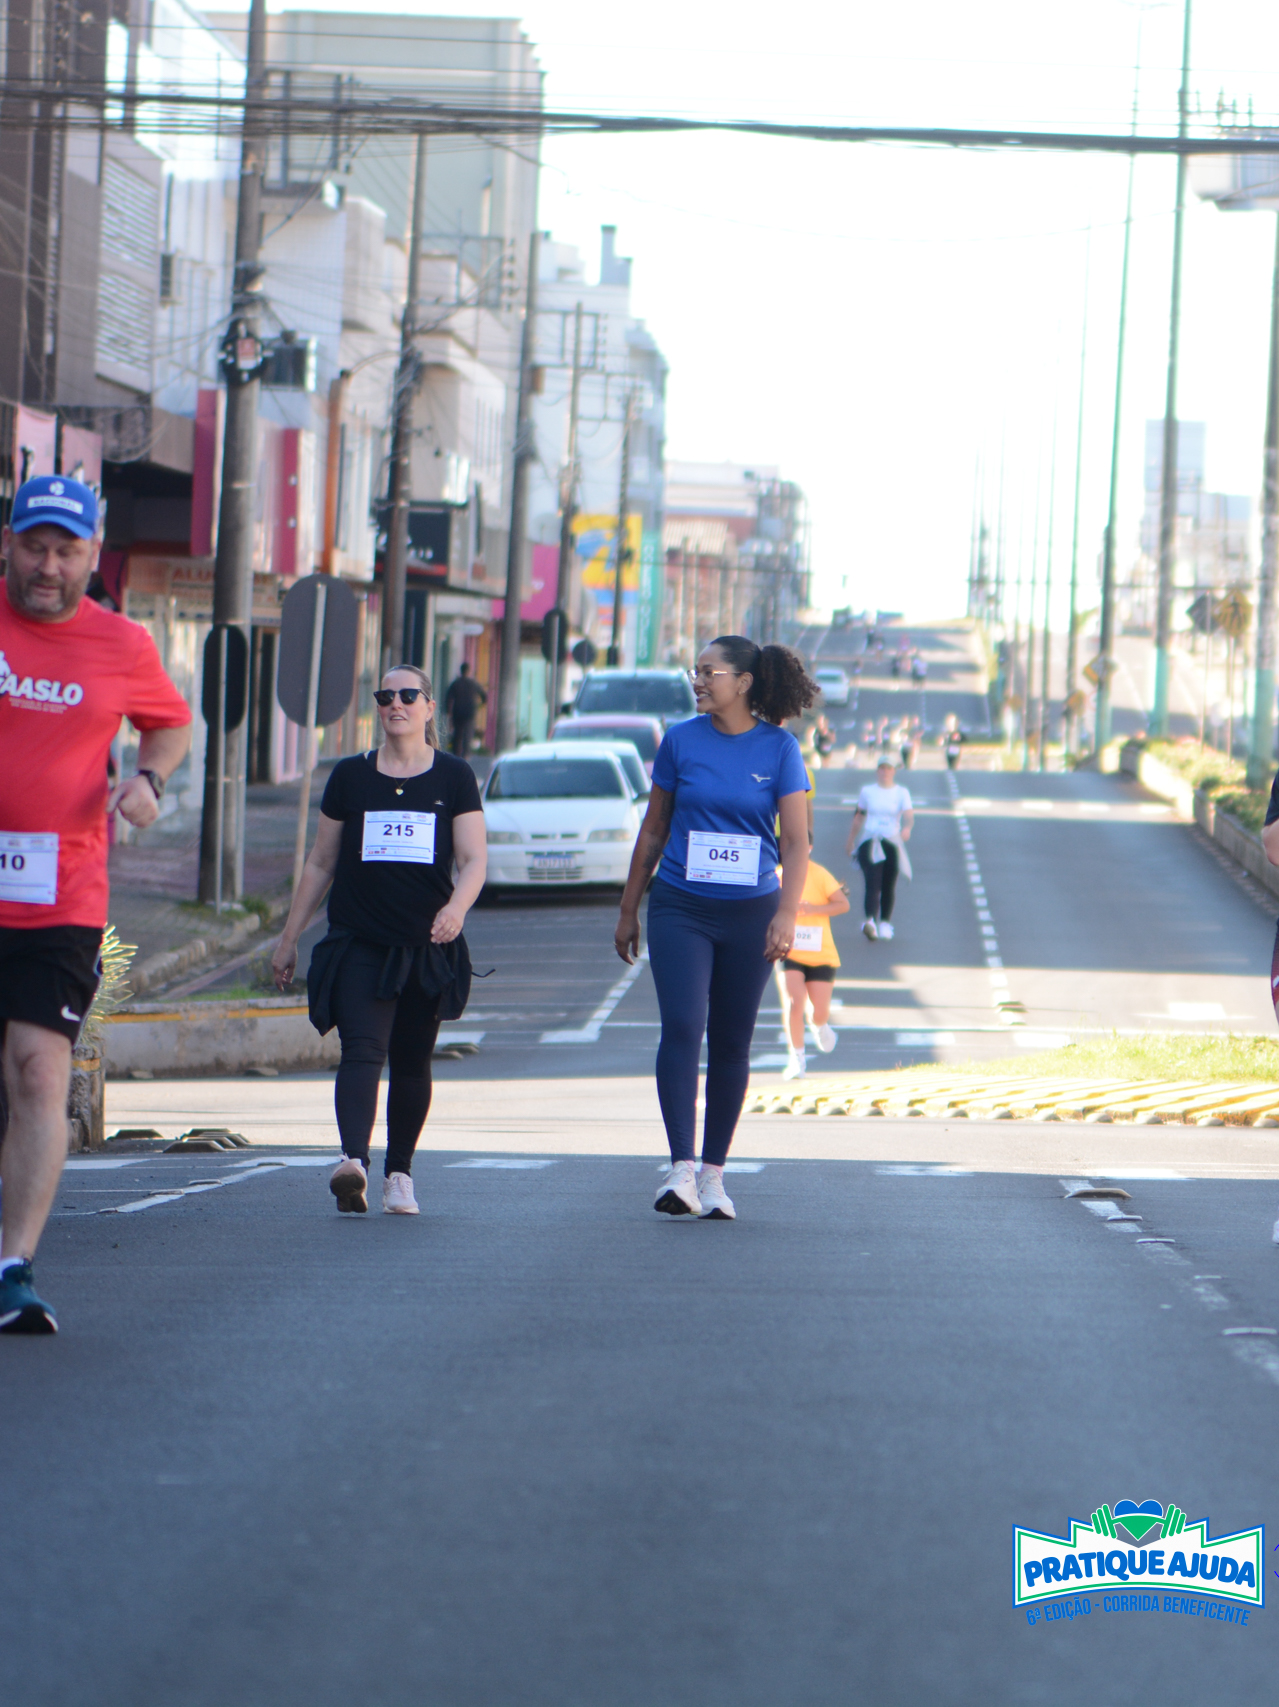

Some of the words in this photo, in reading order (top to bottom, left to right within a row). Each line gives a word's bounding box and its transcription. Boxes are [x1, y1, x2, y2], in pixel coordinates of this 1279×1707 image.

[0, 673, 84, 706] AASLO
[383, 824, 414, 837] 215
[709, 848, 740, 863] 045
